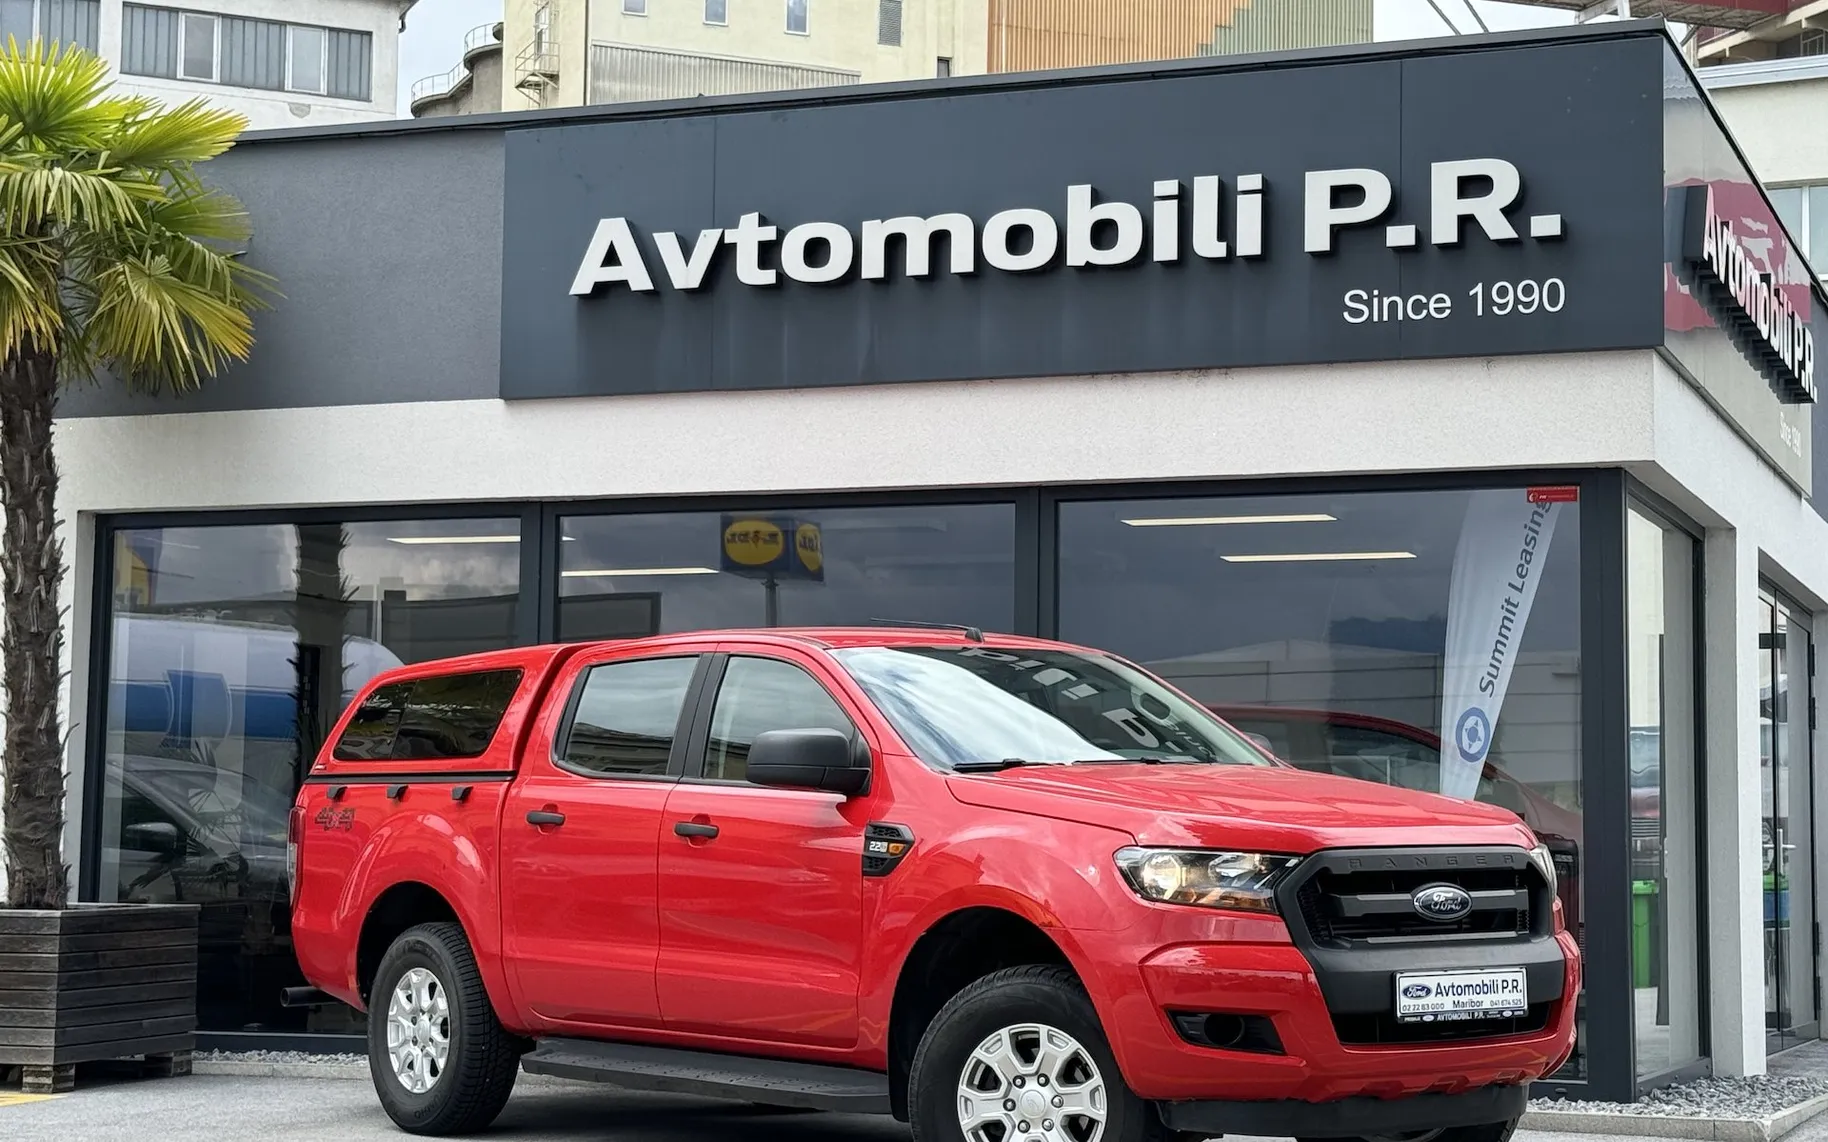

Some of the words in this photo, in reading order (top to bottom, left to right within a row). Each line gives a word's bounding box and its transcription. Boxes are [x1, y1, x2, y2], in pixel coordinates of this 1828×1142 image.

[569, 173, 1263, 296] Avtomobili
[1304, 158, 1563, 253] P.R.
[1703, 184, 1792, 370] Avtomobili
[1342, 289, 1452, 324] Since
[1468, 277, 1566, 317] 1990
[1479, 595, 1520, 699] Summit
[1349, 854, 1515, 869] RANGER
[1430, 891, 1463, 912] Ford
[1405, 985, 1430, 998] Ford
[1435, 979, 1499, 998] Avtomobili
[1500, 978, 1523, 994] P.R.
[1452, 999, 1484, 1009] Maribor
